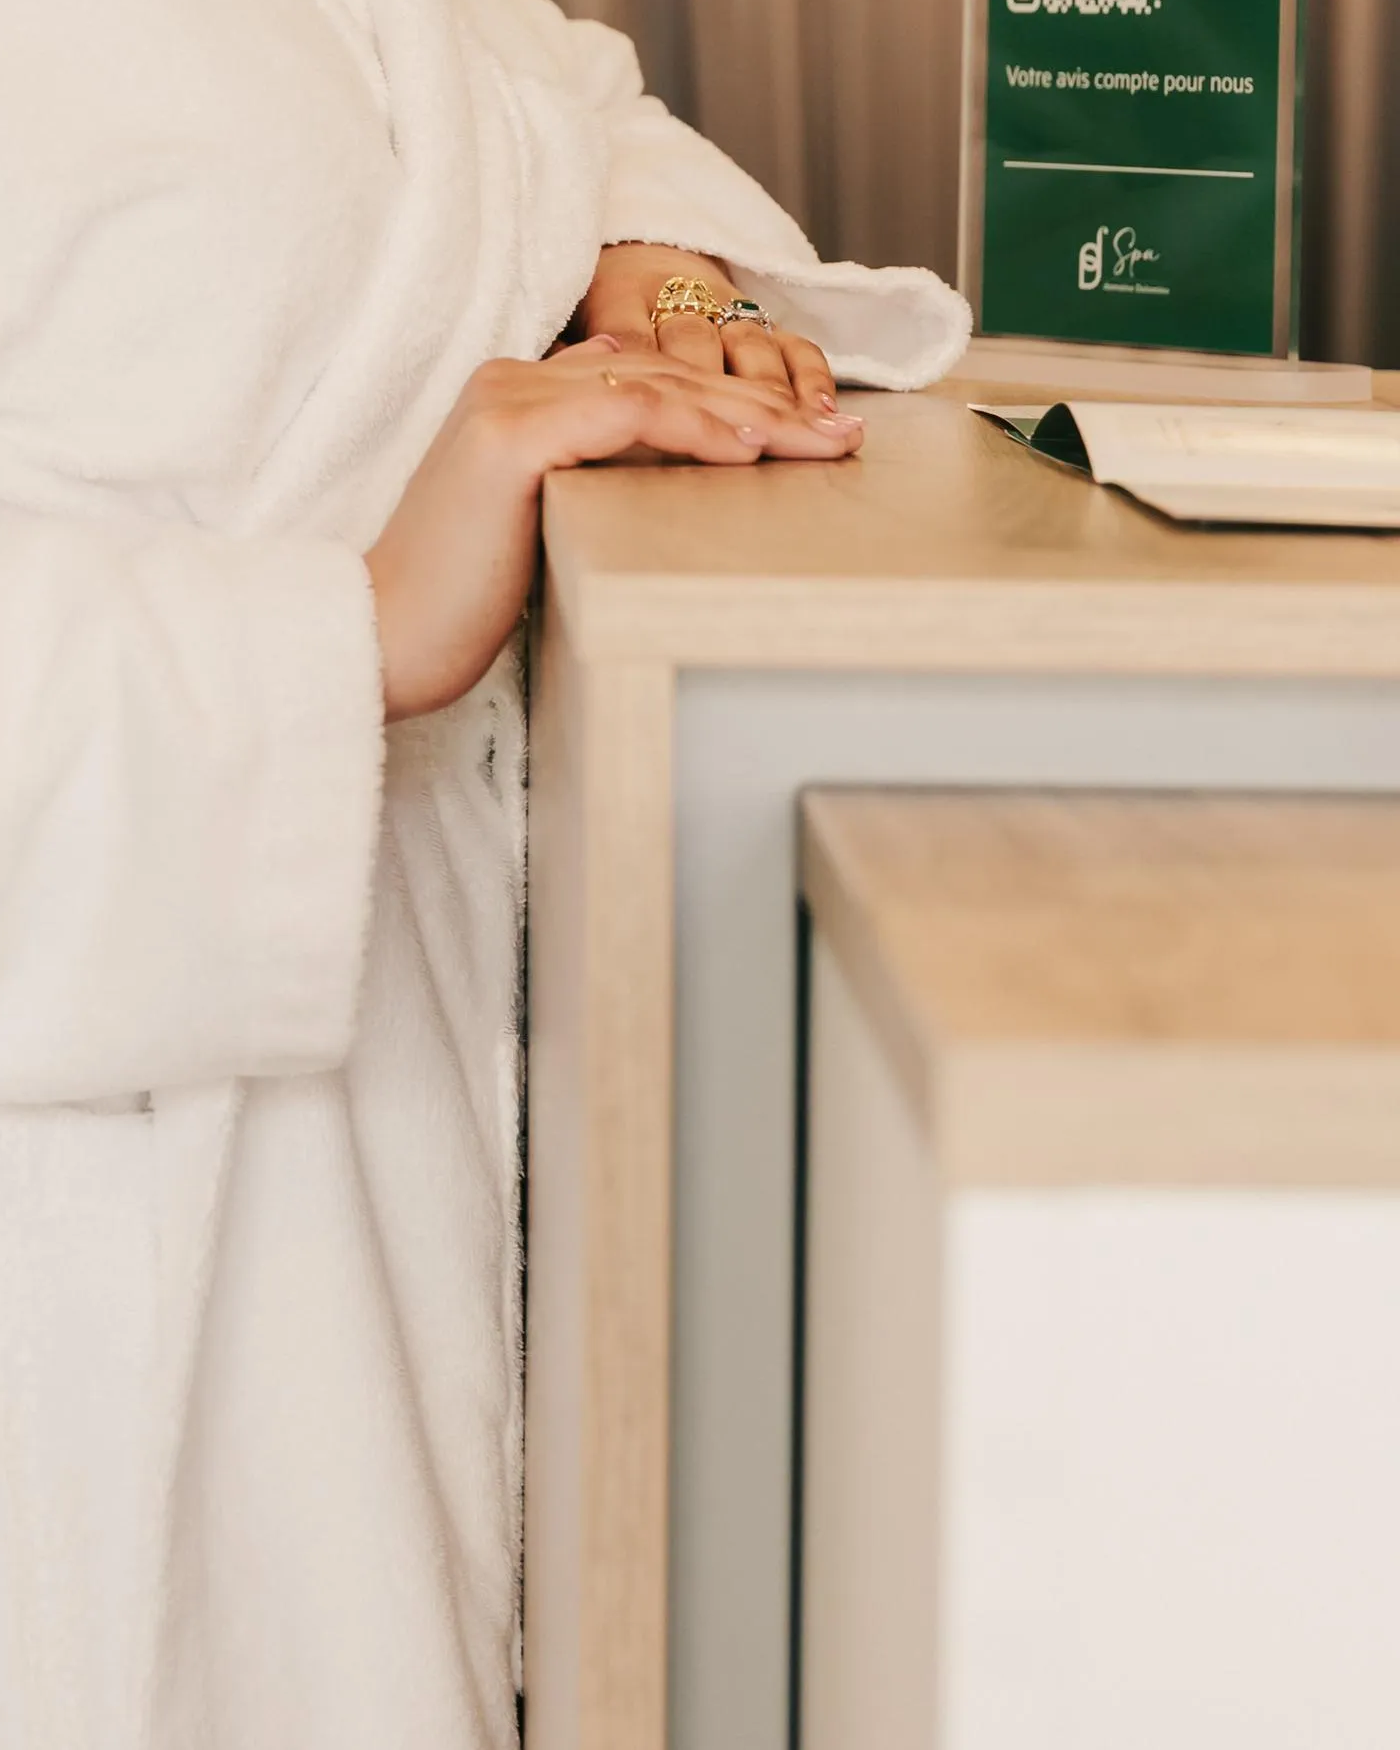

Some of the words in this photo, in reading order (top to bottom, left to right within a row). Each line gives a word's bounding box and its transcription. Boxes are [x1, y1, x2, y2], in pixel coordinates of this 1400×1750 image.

[1005, 64, 1053, 89] Votre
[1055, 67, 1091, 89] avis
[1094, 71, 1160, 95] compte
[1164, 74, 1206, 96] pour
[1210, 75, 1254, 95] nous
[1112, 226, 1160, 278] Spa
